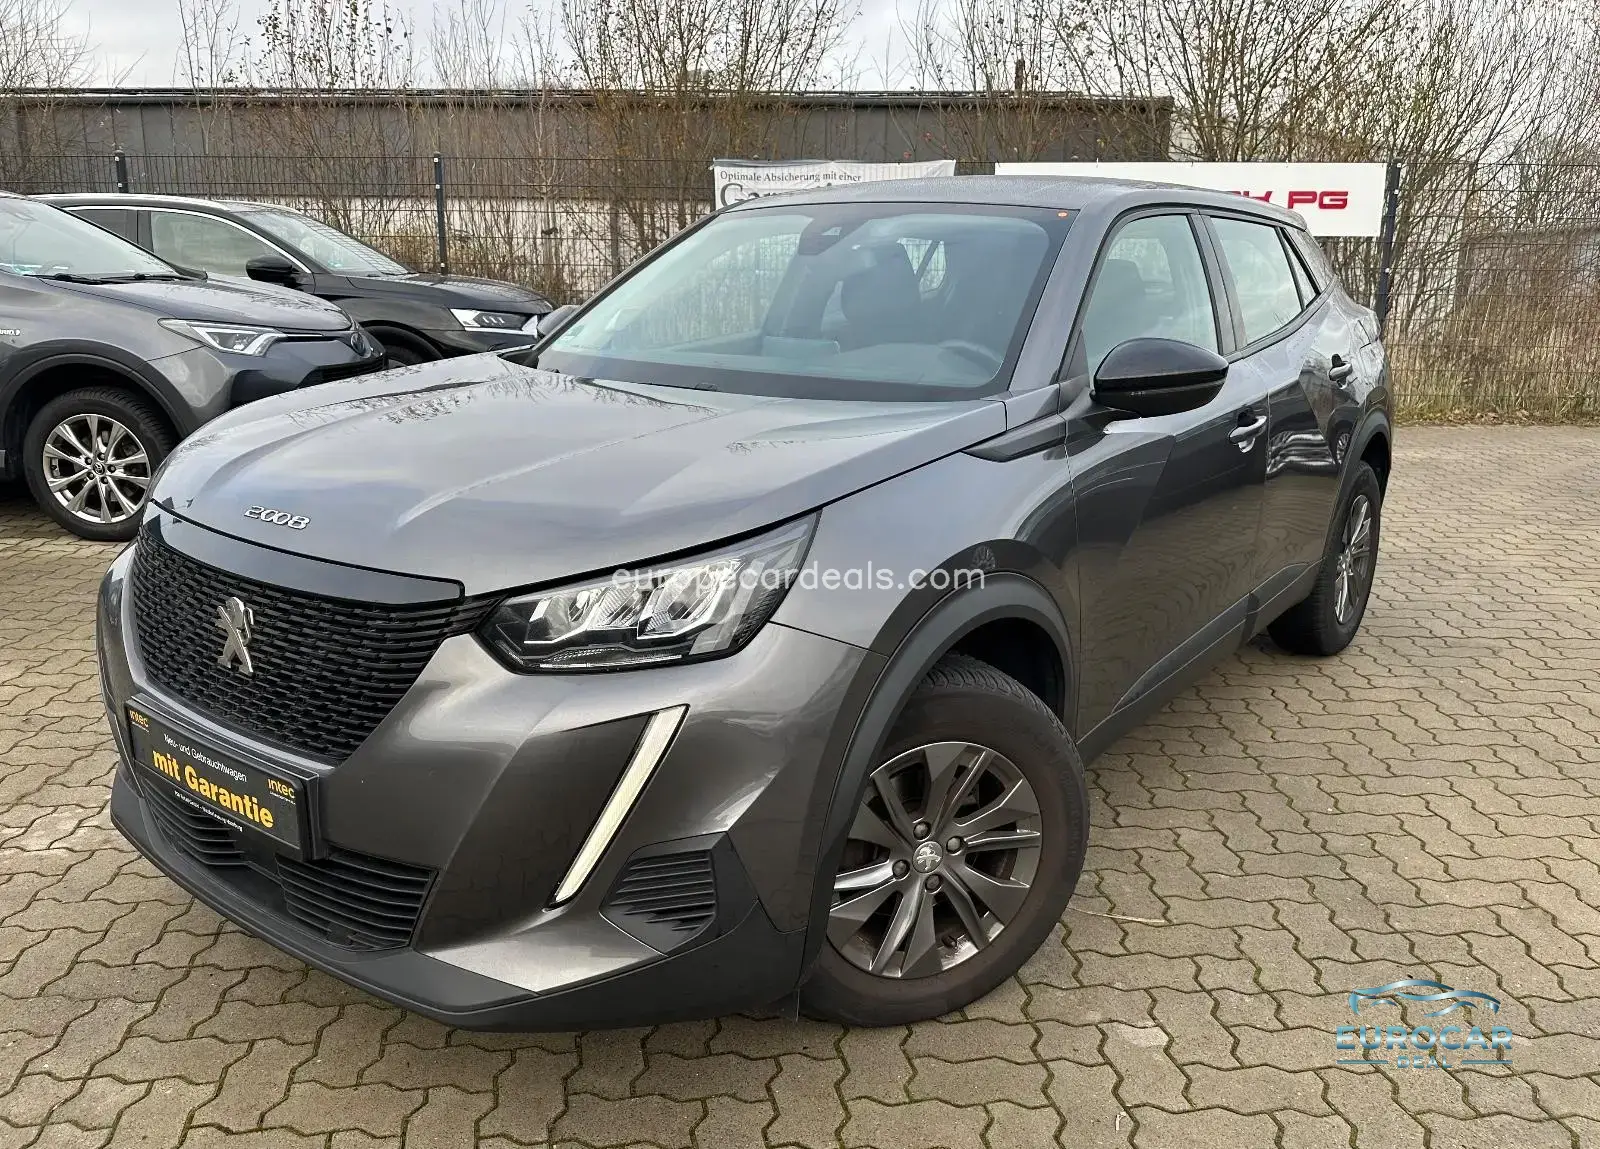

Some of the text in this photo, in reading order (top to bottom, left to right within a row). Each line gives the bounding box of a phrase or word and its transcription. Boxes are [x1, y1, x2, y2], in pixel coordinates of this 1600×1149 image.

[720, 170, 862, 183] Optimale Absicherung mit einer
[1287, 191, 1348, 210] PG
[244, 505, 311, 530] 2008
[179, 744, 191, 756] und
[153, 750, 181, 782] mit
[184, 765, 274, 828] Garantie
